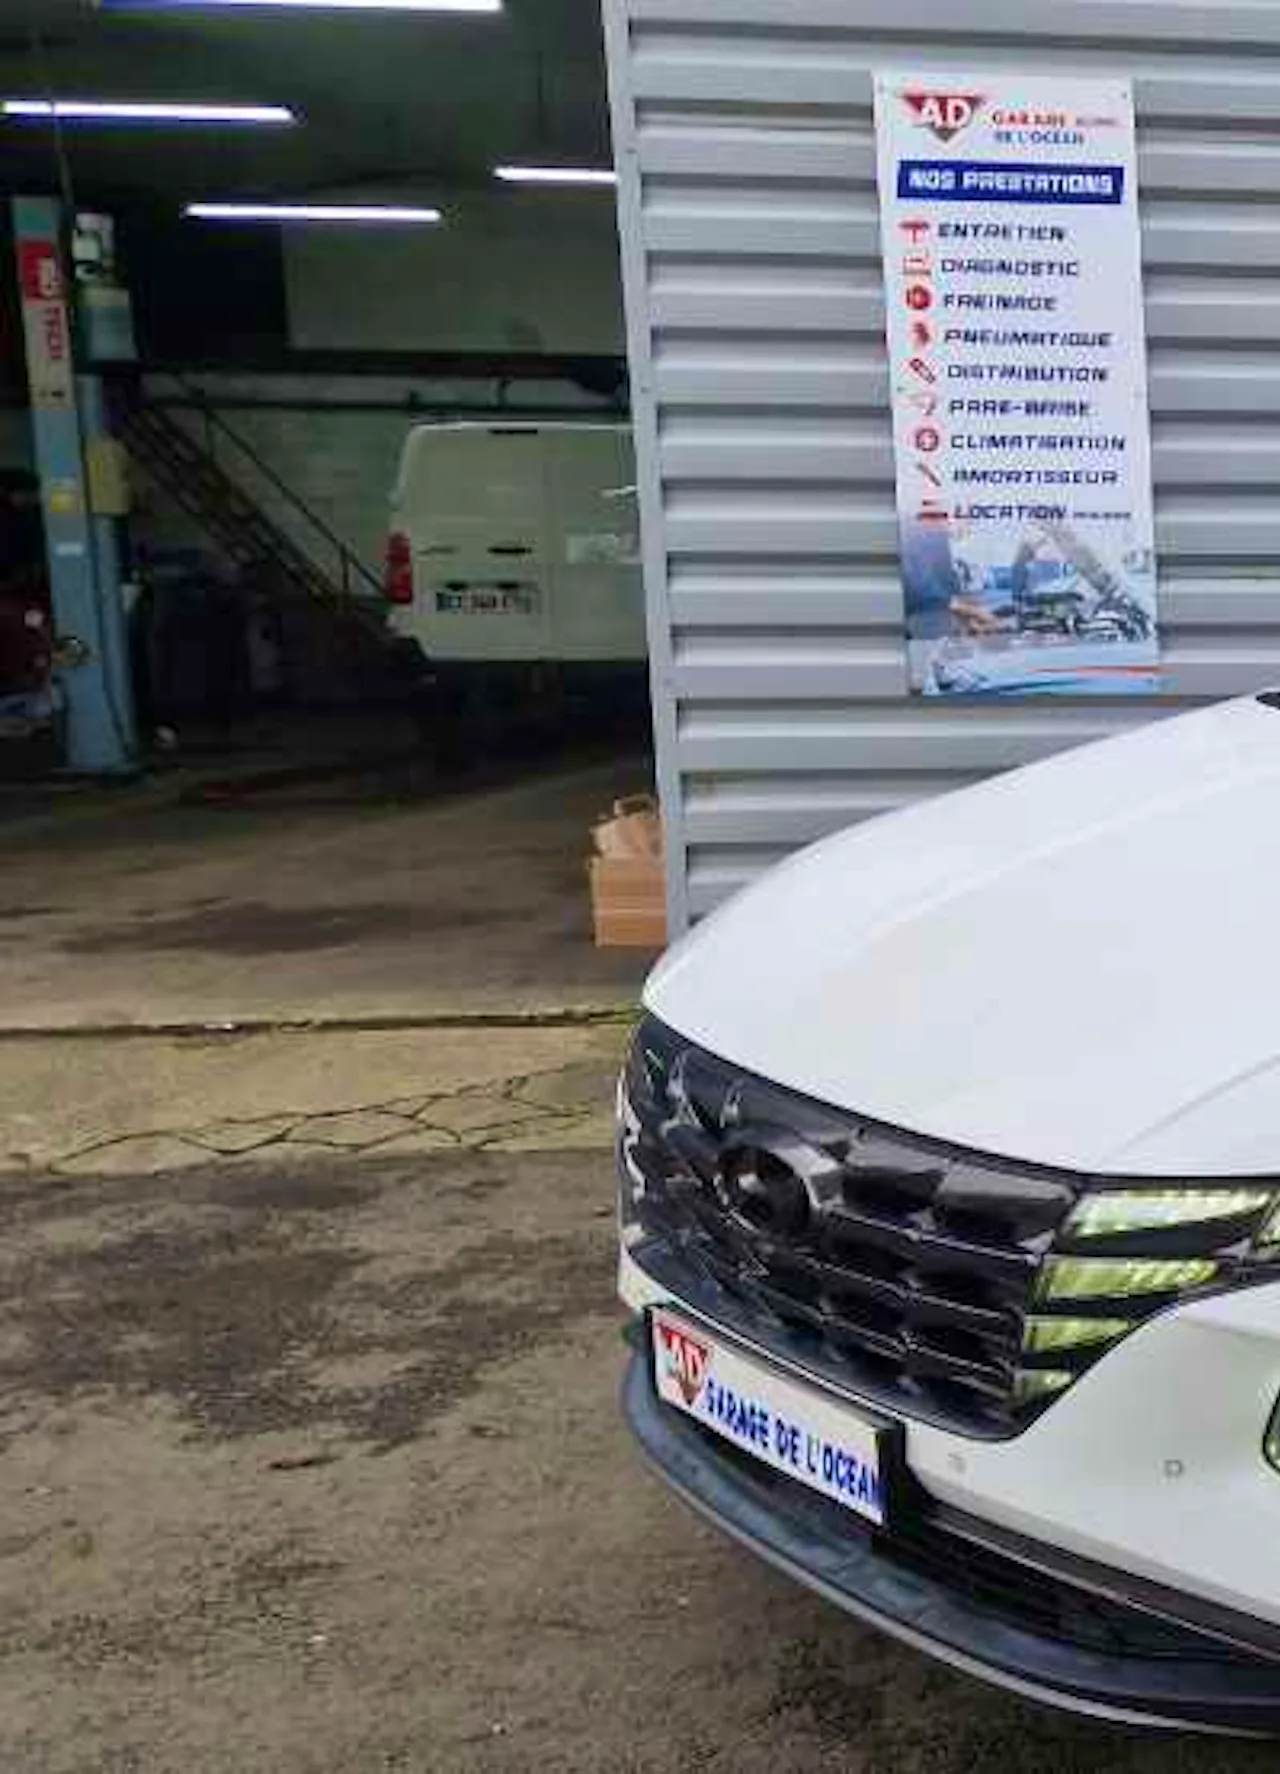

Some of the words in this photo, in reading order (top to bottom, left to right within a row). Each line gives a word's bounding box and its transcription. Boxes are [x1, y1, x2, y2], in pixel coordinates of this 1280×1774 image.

[921, 97, 972, 128] AD
[908, 168, 956, 189] NOS
[961, 170, 1114, 195] PRESTATIONS
[937, 222, 1066, 243] ENTRETIEN
[940, 257, 1080, 277] DIAGNOSTIC
[942, 292, 1060, 312] FREINAGE
[943, 328, 1113, 348] PNEUMATIQUE
[947, 363, 1110, 383] DISTRIBUTION
[949, 399, 1091, 417] PARE-BRISE
[950, 434, 1127, 452] CLIMATISATION
[952, 468, 1119, 485] AMORTISSEUR
[954, 504, 1067, 520] LOCATION
[706, 1378, 770, 1448] GARAGE
[776, 1418, 801, 1466] DE
